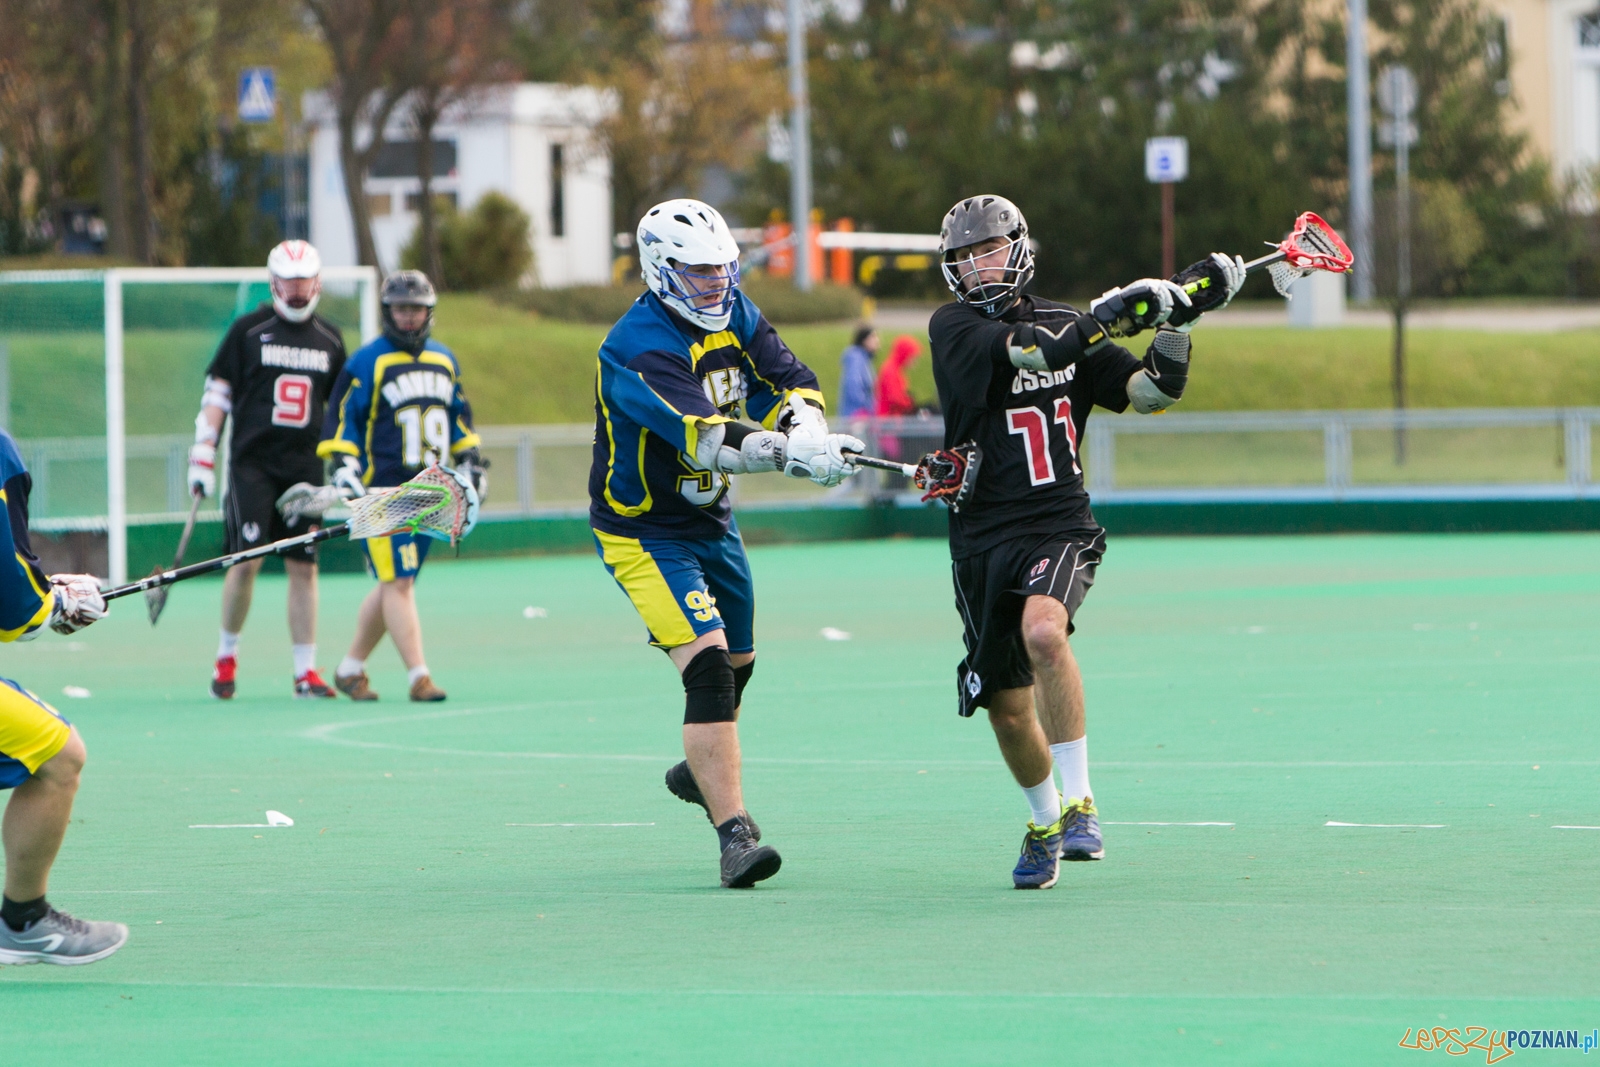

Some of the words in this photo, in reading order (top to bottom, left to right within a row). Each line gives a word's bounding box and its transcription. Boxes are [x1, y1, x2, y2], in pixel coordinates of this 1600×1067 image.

[271, 373, 313, 429] 9
[395, 404, 451, 470] 19
[1005, 395, 1082, 487] 11
